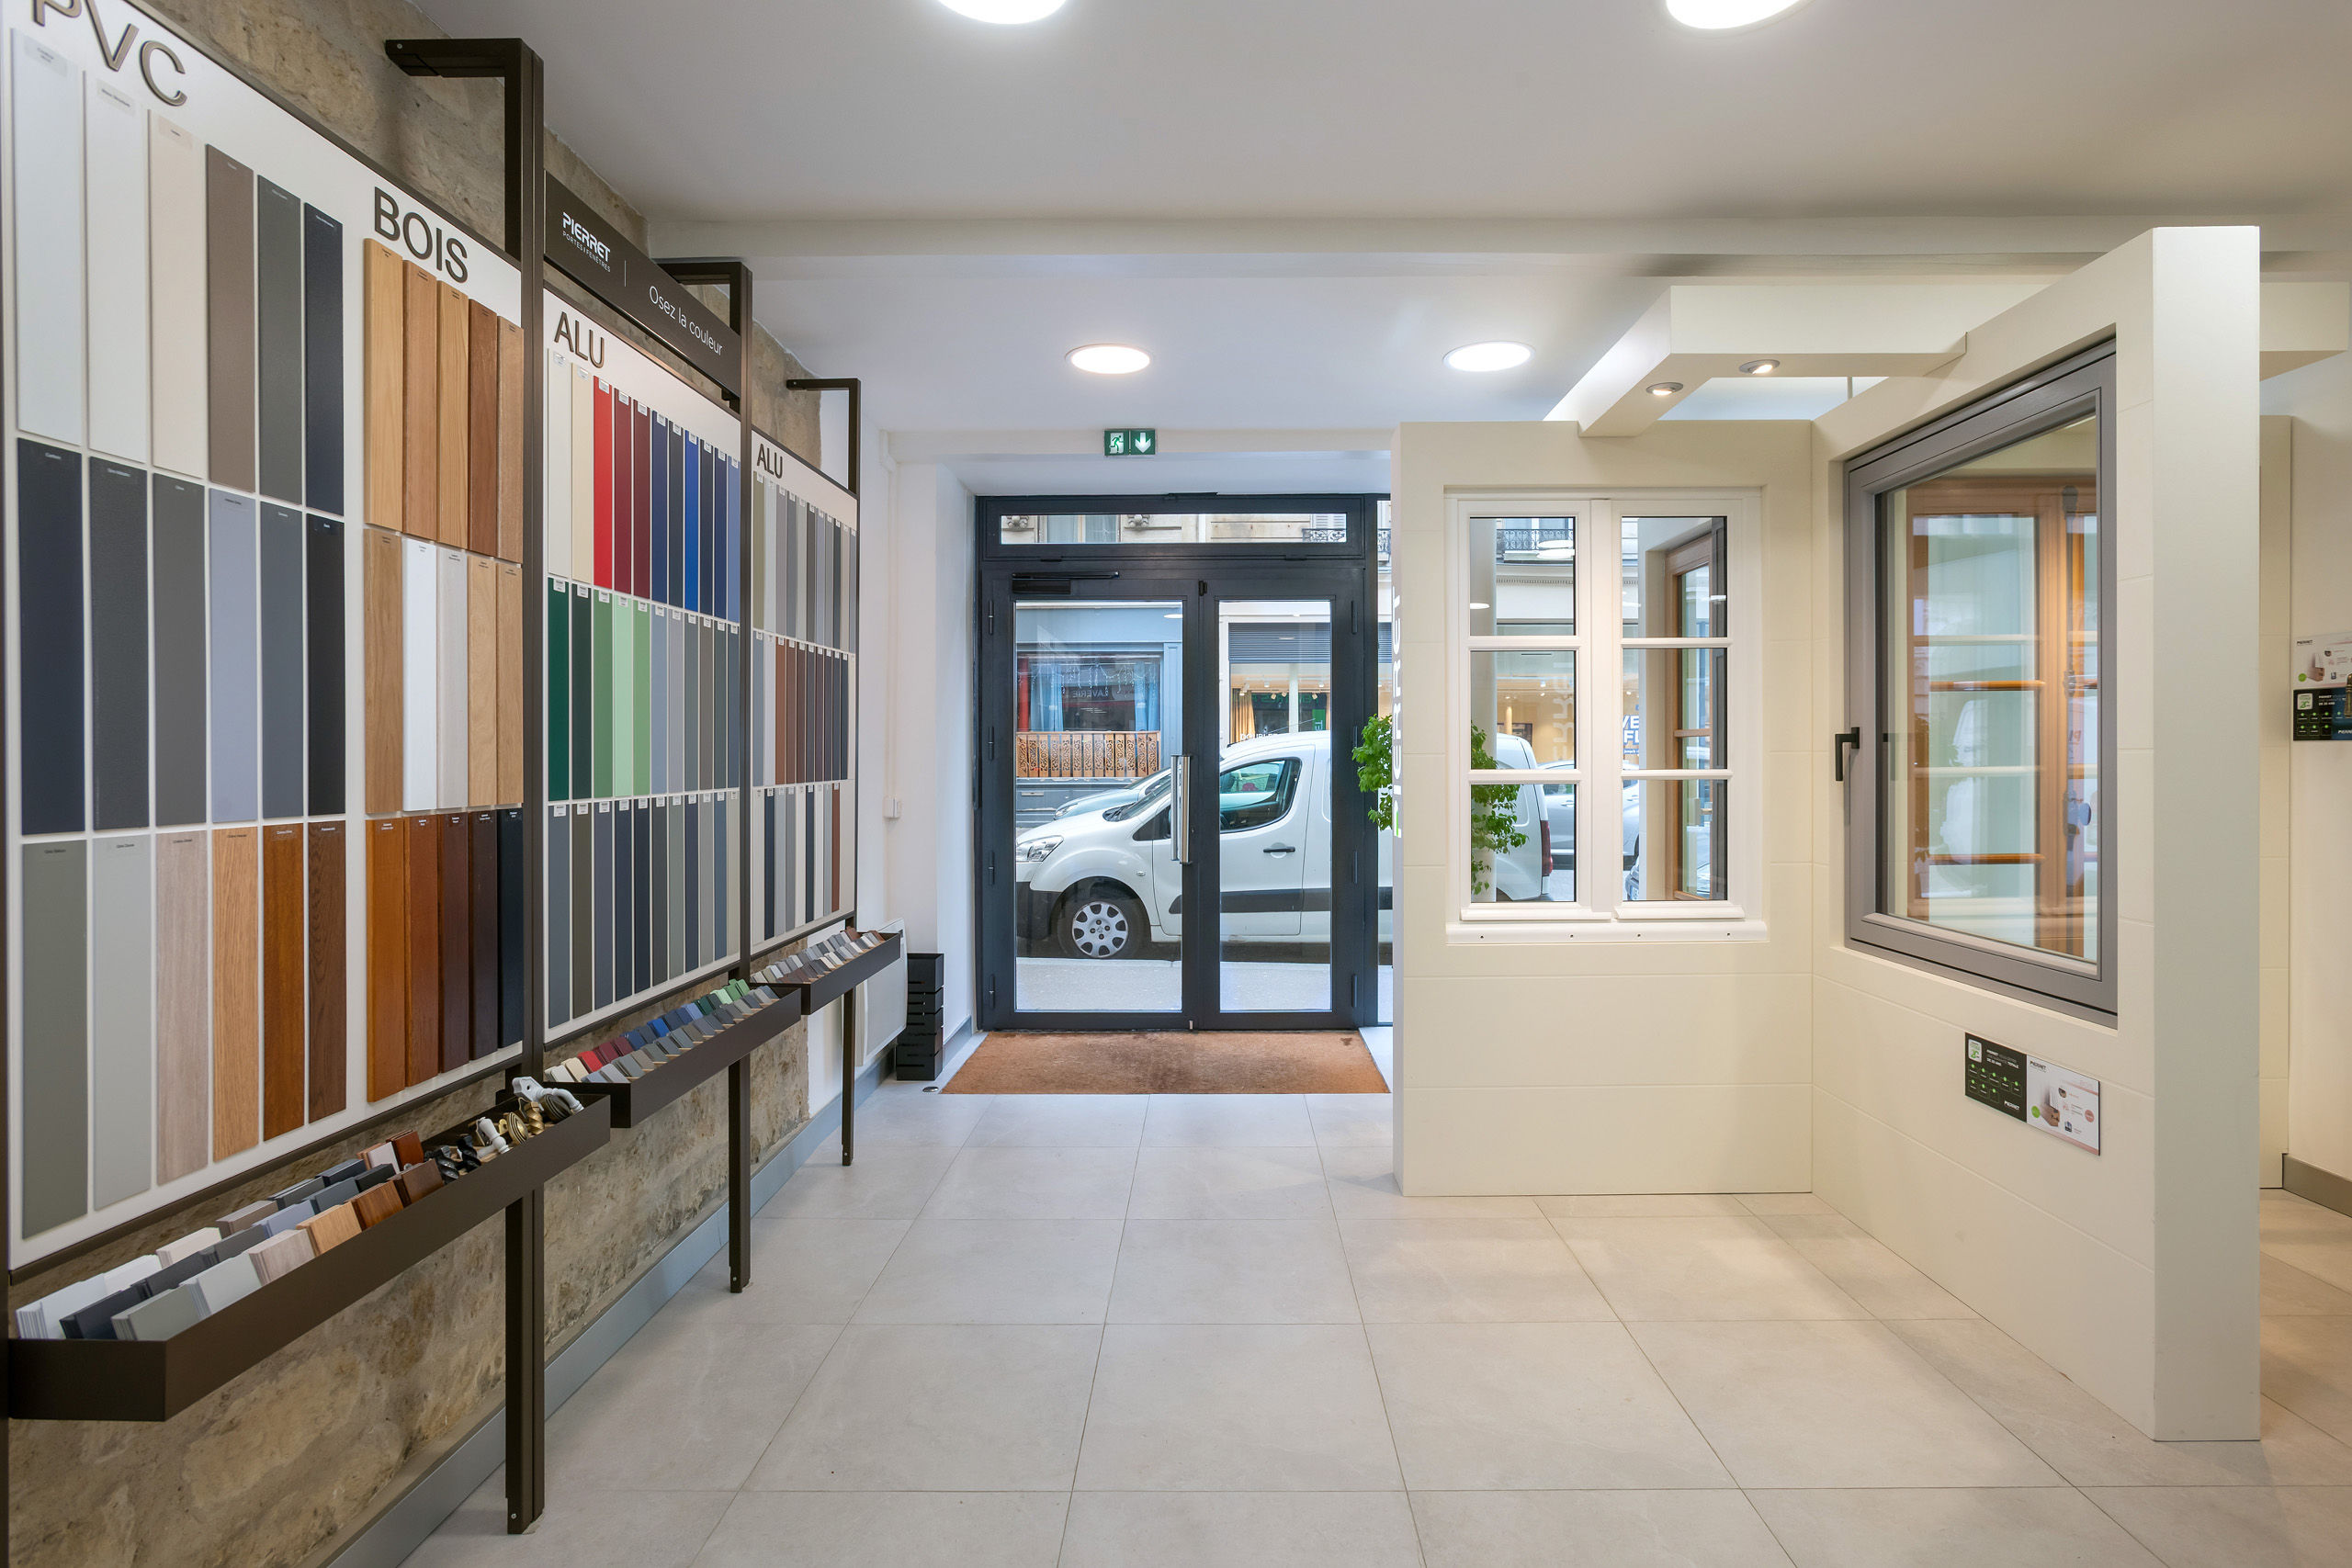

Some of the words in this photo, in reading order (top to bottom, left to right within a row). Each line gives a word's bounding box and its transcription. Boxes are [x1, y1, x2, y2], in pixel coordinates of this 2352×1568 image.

[375, 186, 468, 283] BOIS
[562, 212, 610, 262] PIERRET
[554, 311, 605, 368] ALU
[650, 286, 675, 320] Osez
[679, 308, 687, 328] la
[689, 321, 723, 355] couleur
[757, 444, 783, 479] ALU
